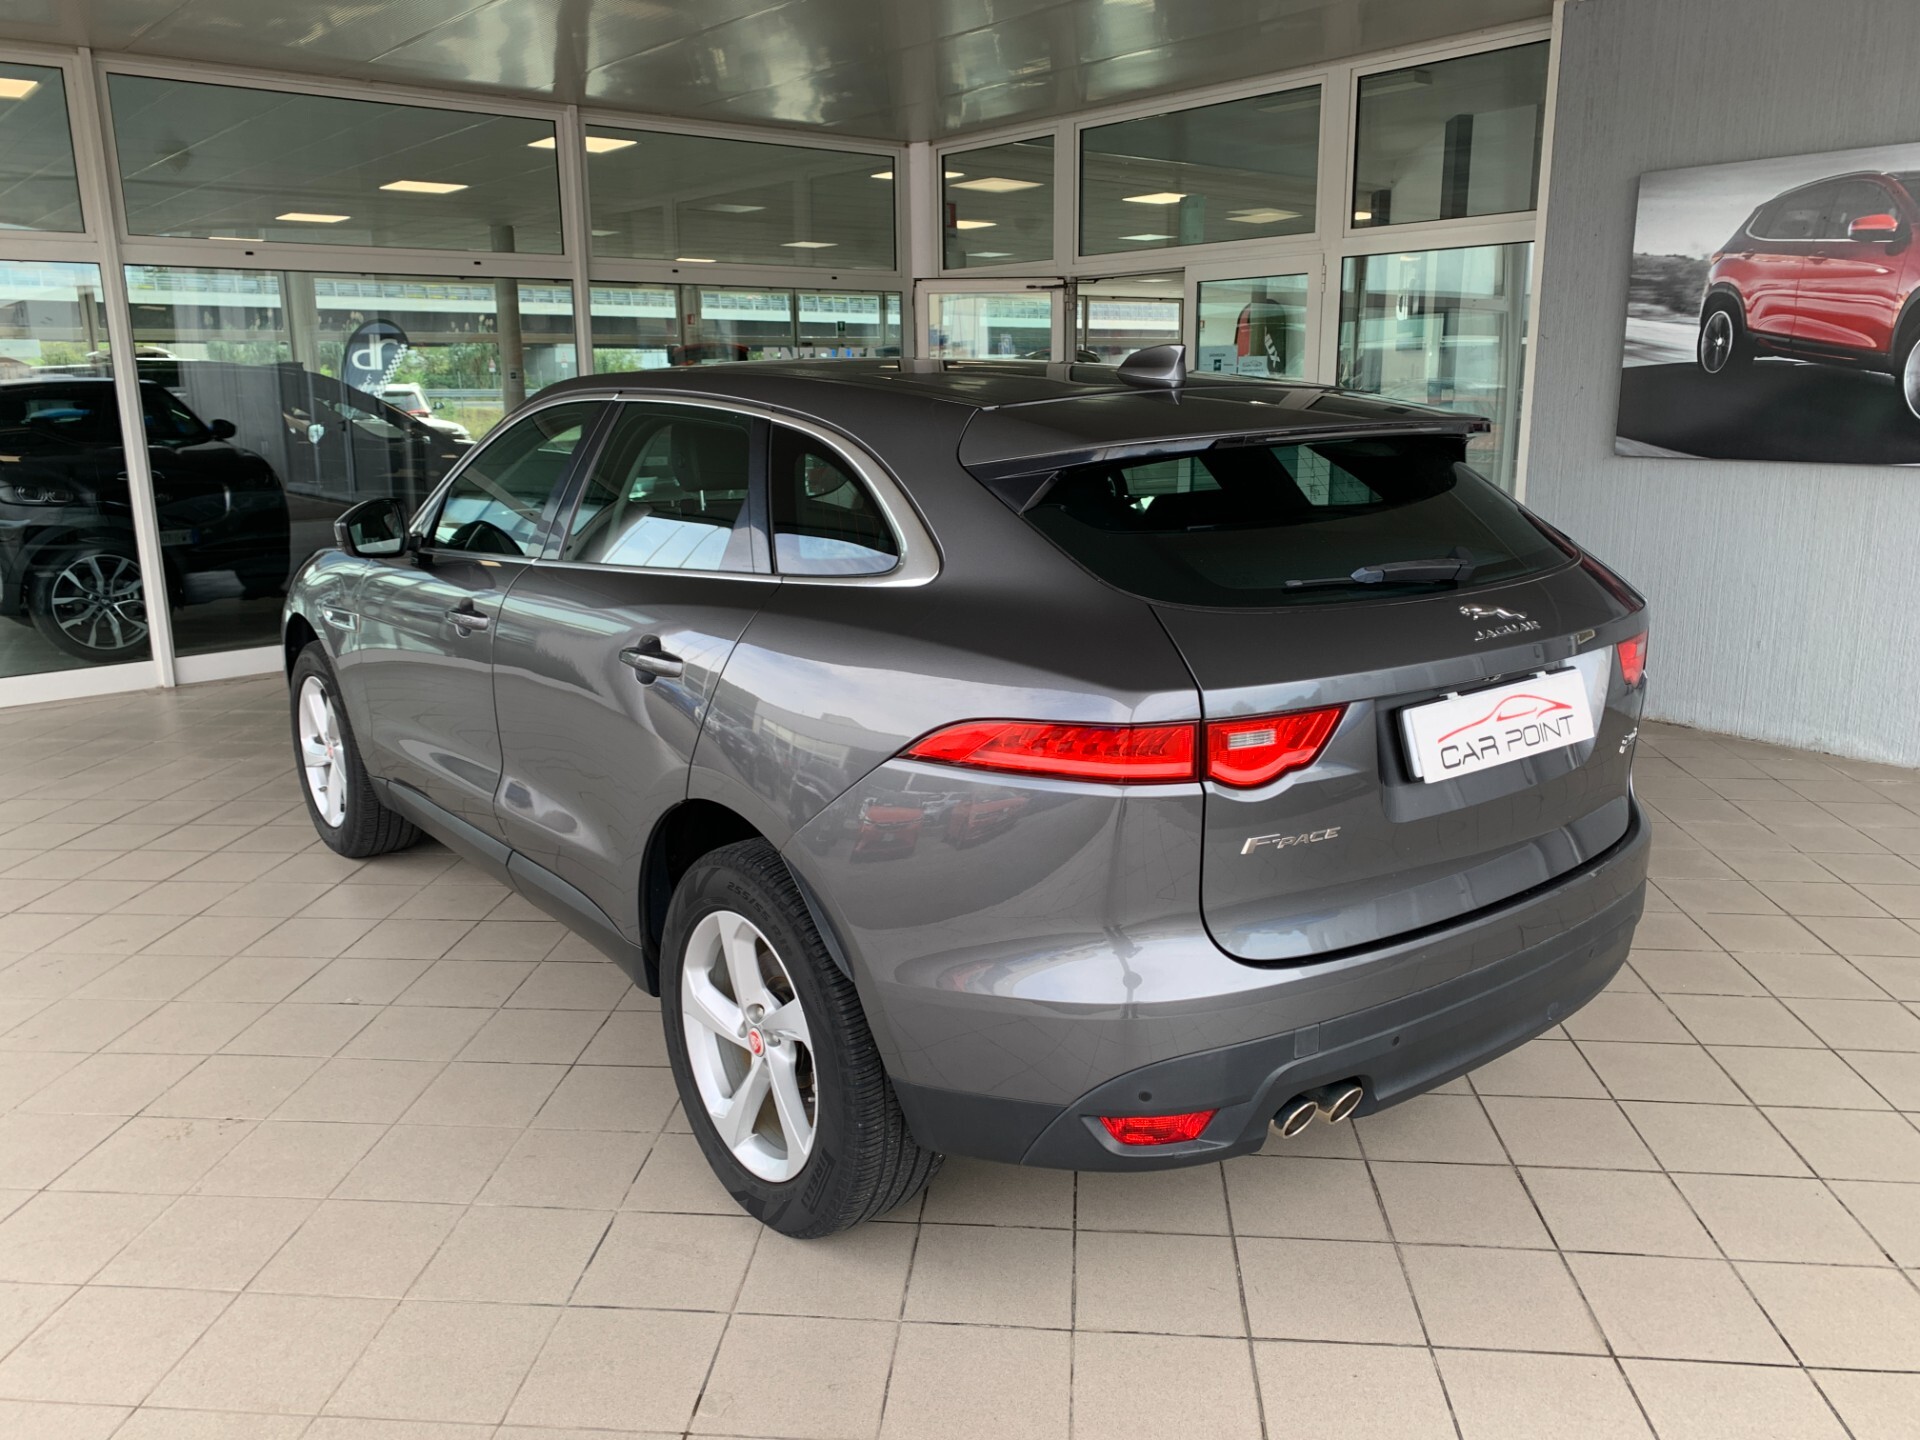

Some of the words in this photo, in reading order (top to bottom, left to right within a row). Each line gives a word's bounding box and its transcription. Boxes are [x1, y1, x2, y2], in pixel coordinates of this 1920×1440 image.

[1474, 620, 1541, 641] JAGUAR
[1440, 737, 1500, 769] CAR
[1505, 714, 1574, 753] POINT
